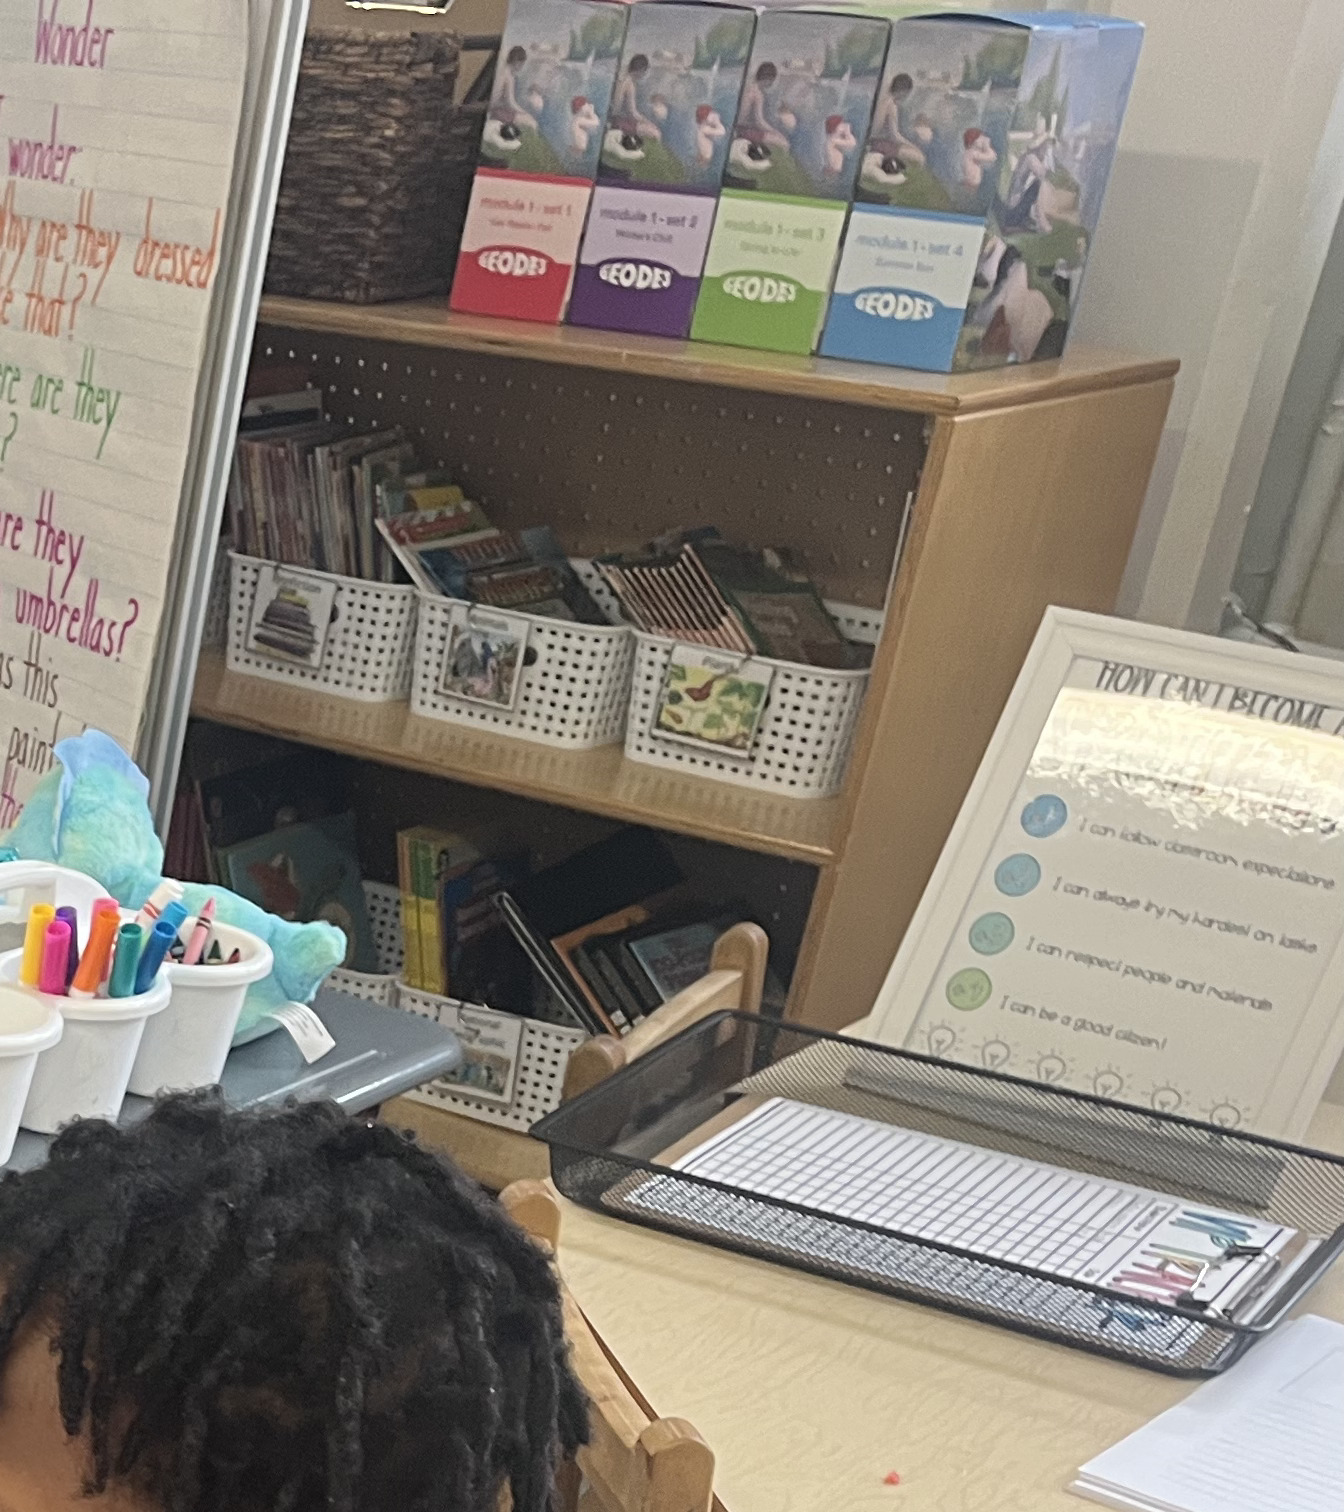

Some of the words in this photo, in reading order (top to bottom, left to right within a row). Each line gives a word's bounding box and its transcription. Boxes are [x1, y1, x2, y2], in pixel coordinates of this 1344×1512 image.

[34, 0, 114, 69] Wonder
[36, 220, 67, 262] are
[74, 188, 121, 305] they
[134, 197, 221, 289] dressed
[30, 374, 64, 415] are
[73, 346, 121, 460] they
[34, 489, 84, 599] they
[16, 565, 139, 662] umbrellas?
[23, 631, 59, 708] this
